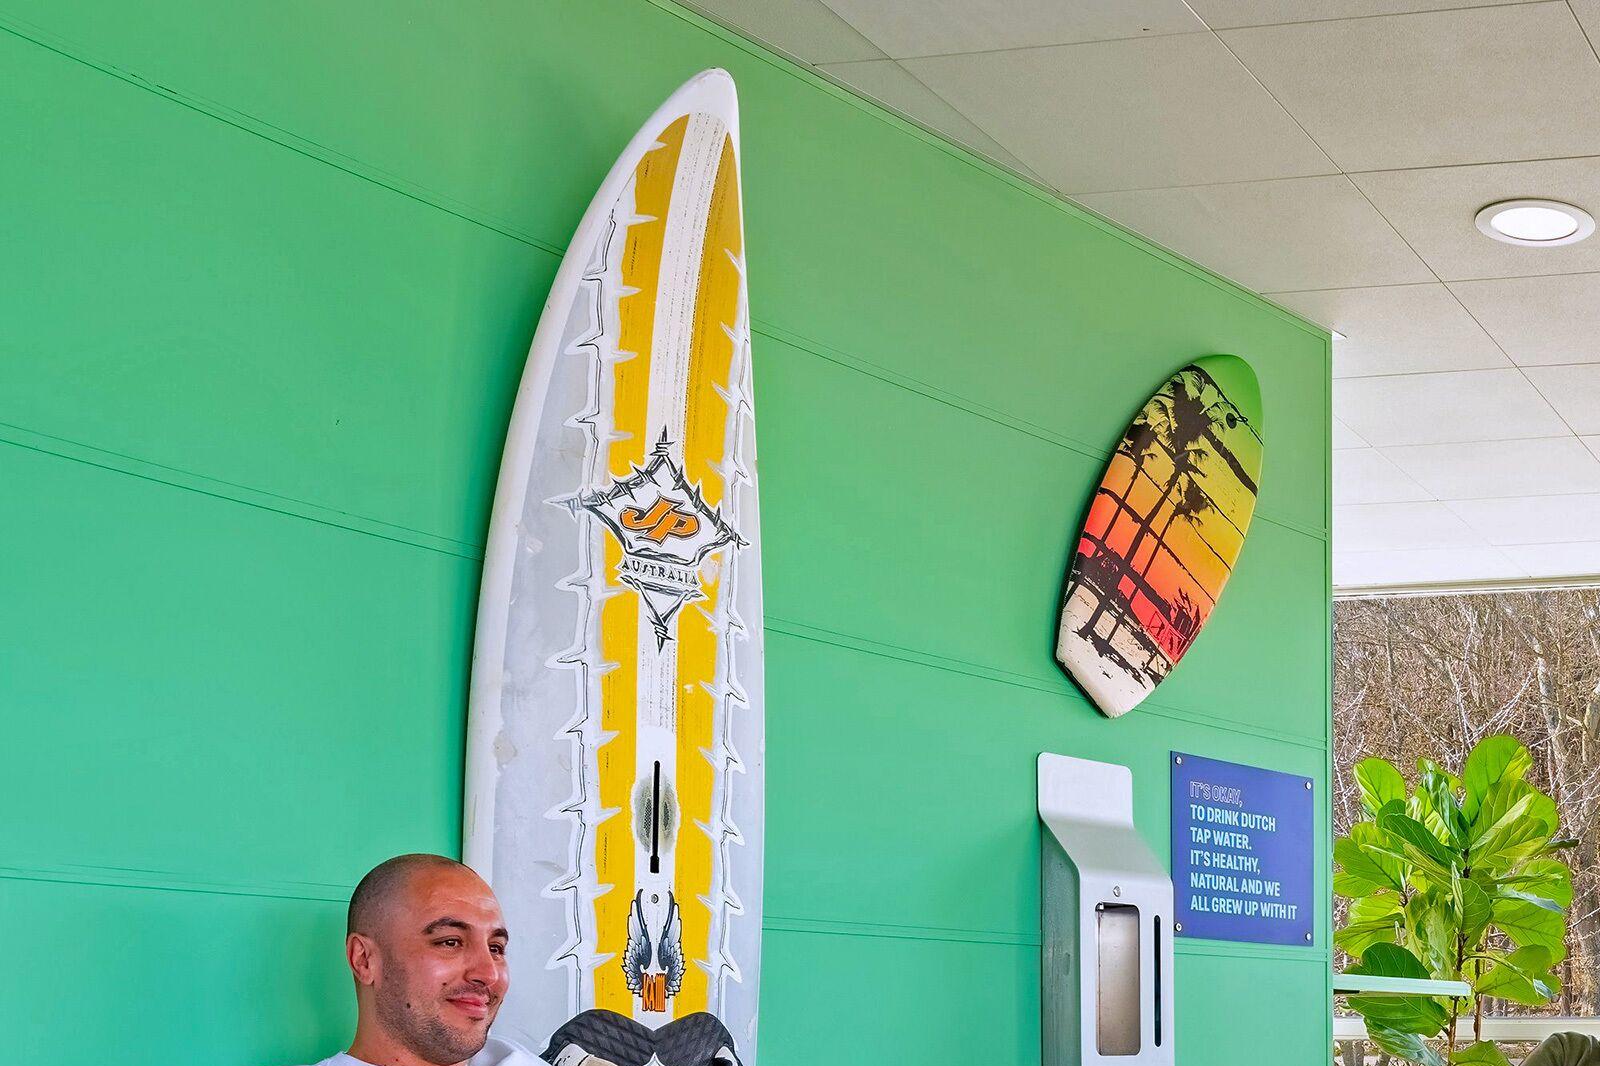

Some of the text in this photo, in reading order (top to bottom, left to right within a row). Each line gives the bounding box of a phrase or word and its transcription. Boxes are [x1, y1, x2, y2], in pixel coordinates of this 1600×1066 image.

[619, 493, 701, 547] JP
[621, 561, 699, 586] AUSTRALIA
[1190, 804, 1276, 831] TO DRINK DUTCH
[1190, 826, 1252, 850] TAP WATER.
[1212, 853, 1260, 875] HEALTHY,
[1190, 872, 1281, 897] NATURAL AND WE
[1190, 895, 1298, 920] ALL GREW UP WITH IT
